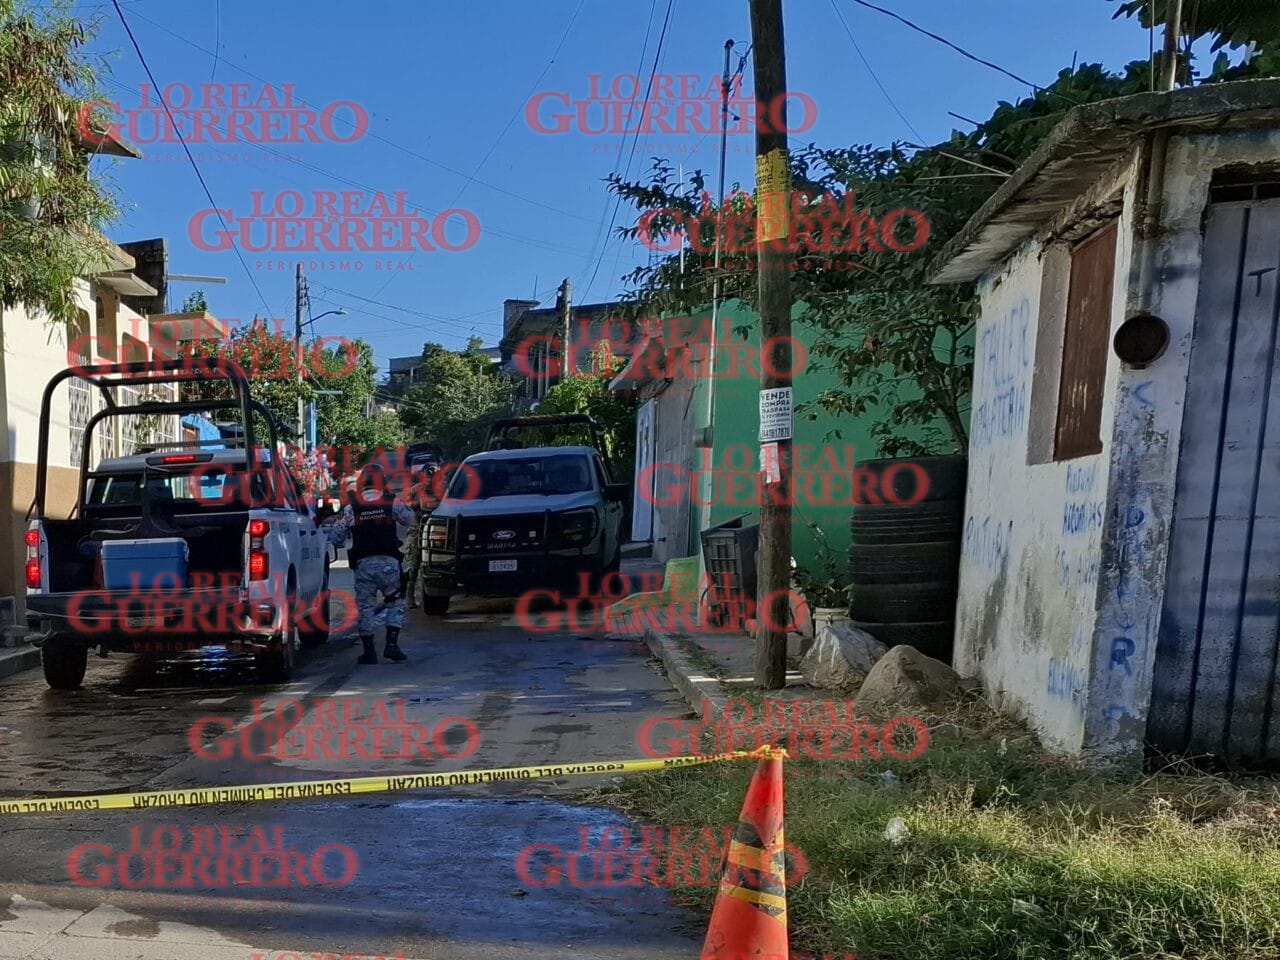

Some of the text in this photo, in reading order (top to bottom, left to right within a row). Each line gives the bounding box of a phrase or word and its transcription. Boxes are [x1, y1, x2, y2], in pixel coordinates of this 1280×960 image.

[980, 298, 1030, 400] TALLER
[761, 391, 790, 400] VENDE
[761, 400, 790, 408] COMPRA
[212, 788, 264, 803] CRIMEN
[269, 786, 294, 799] DEL
[298, 782, 351, 797] ESCENA
[50, 799, 99, 811] ESCENA
[190, 792, 208, 805] NO
[22, 803, 47, 813] DEL
